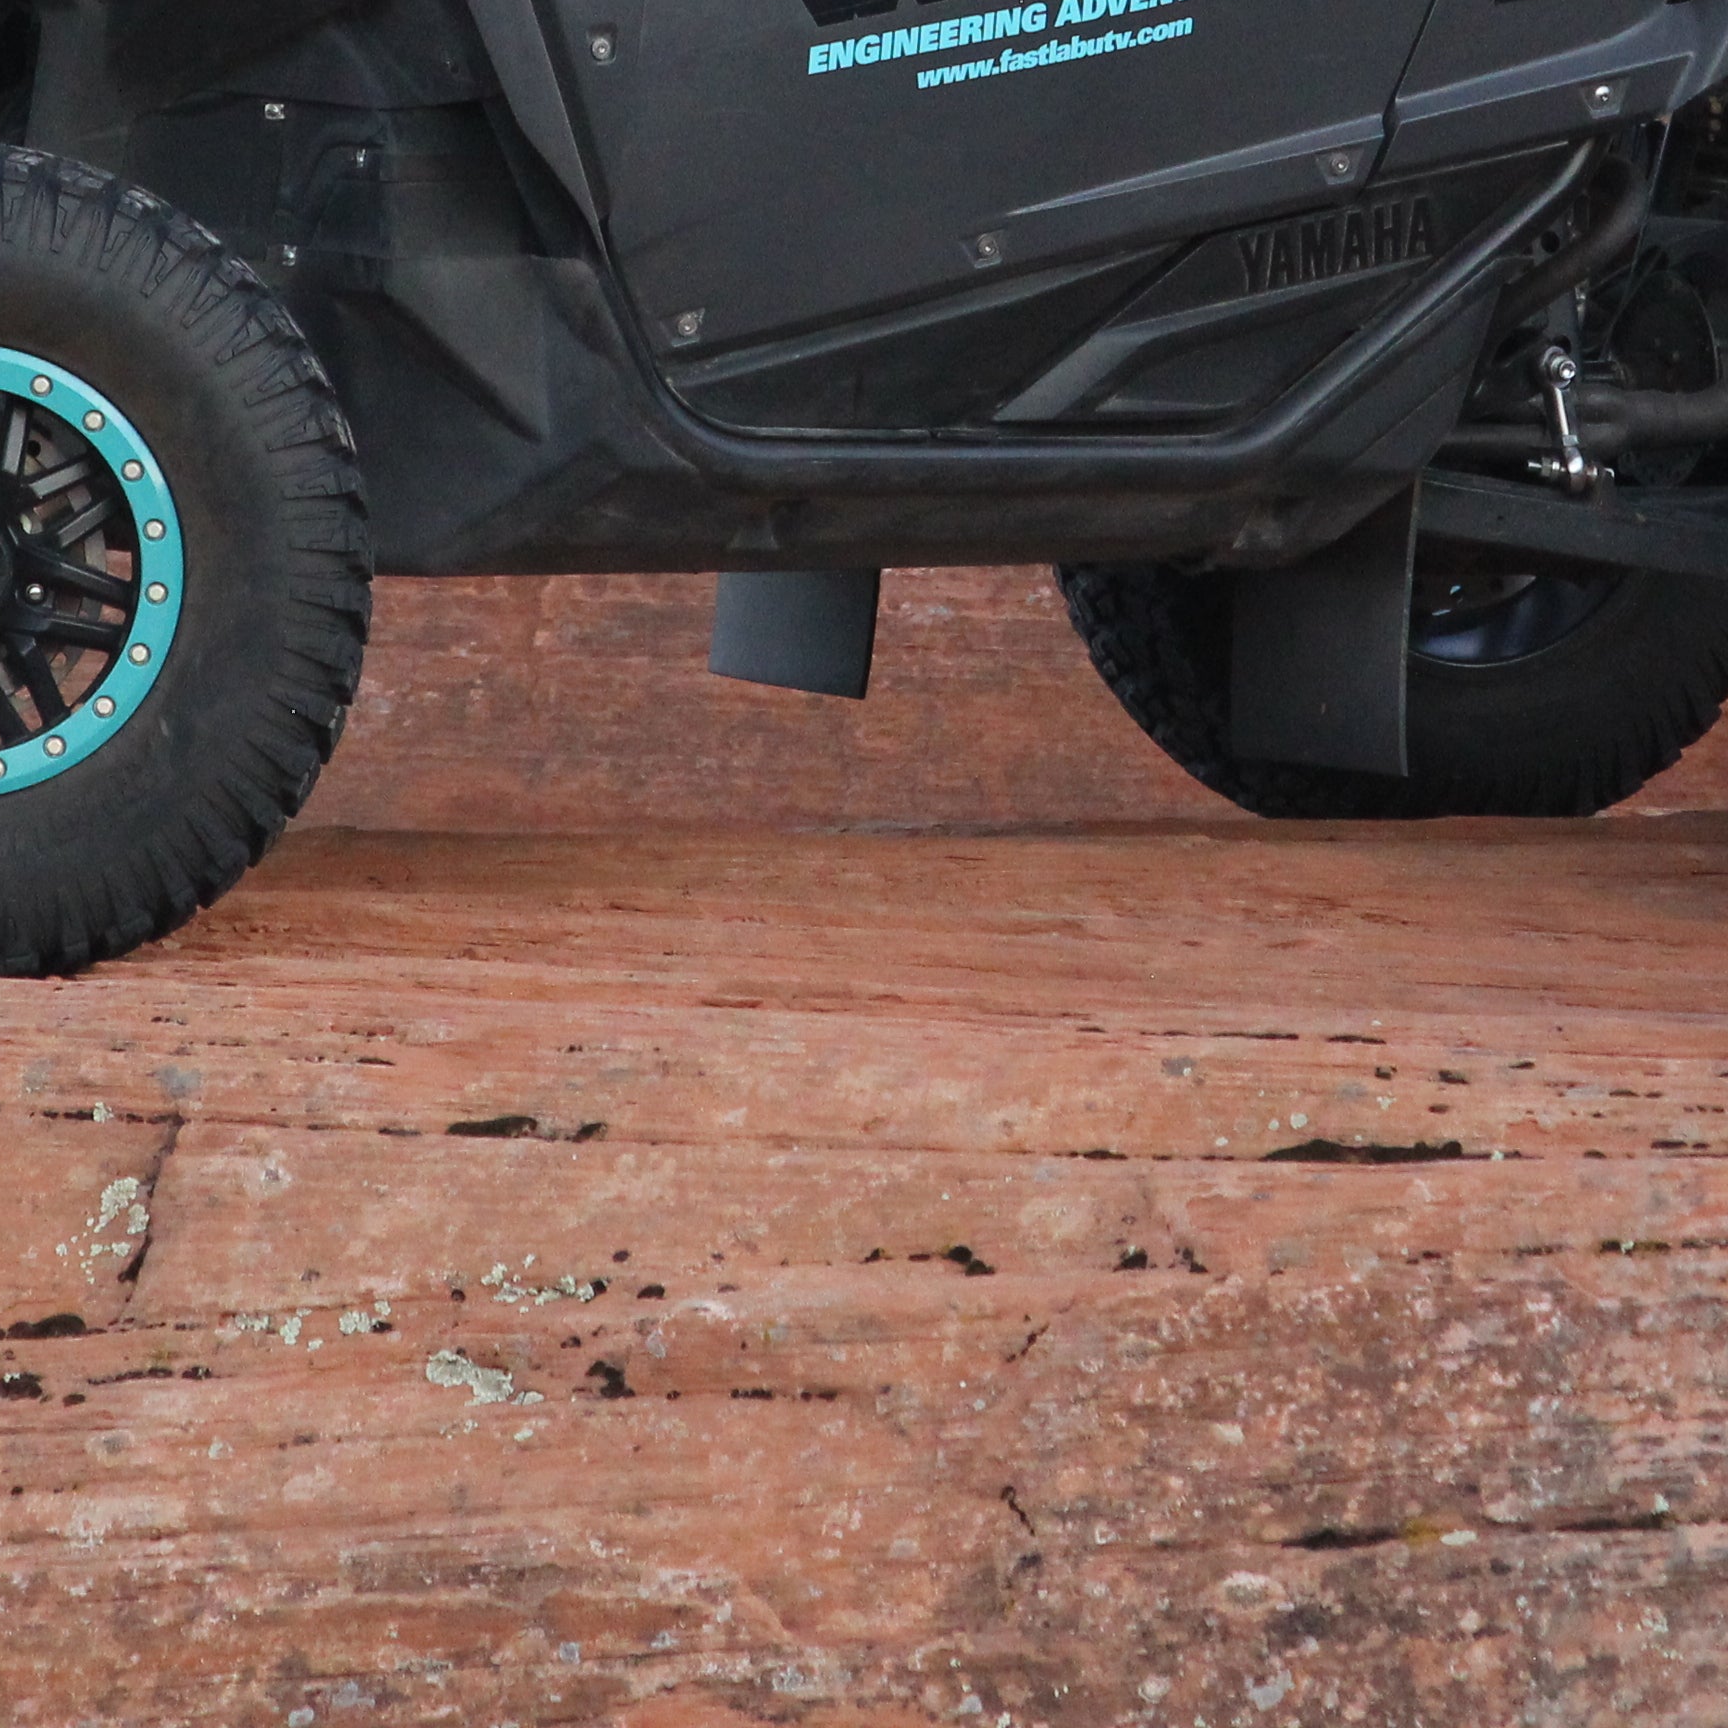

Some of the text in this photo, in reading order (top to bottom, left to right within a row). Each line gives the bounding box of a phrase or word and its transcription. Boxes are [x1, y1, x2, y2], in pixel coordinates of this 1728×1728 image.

[808, 2, 1047, 75] ENGINEERING
[917, 16, 1193, 90] www.fastlabutv.com
[1236, 195, 1431, 293] YAMAHA
